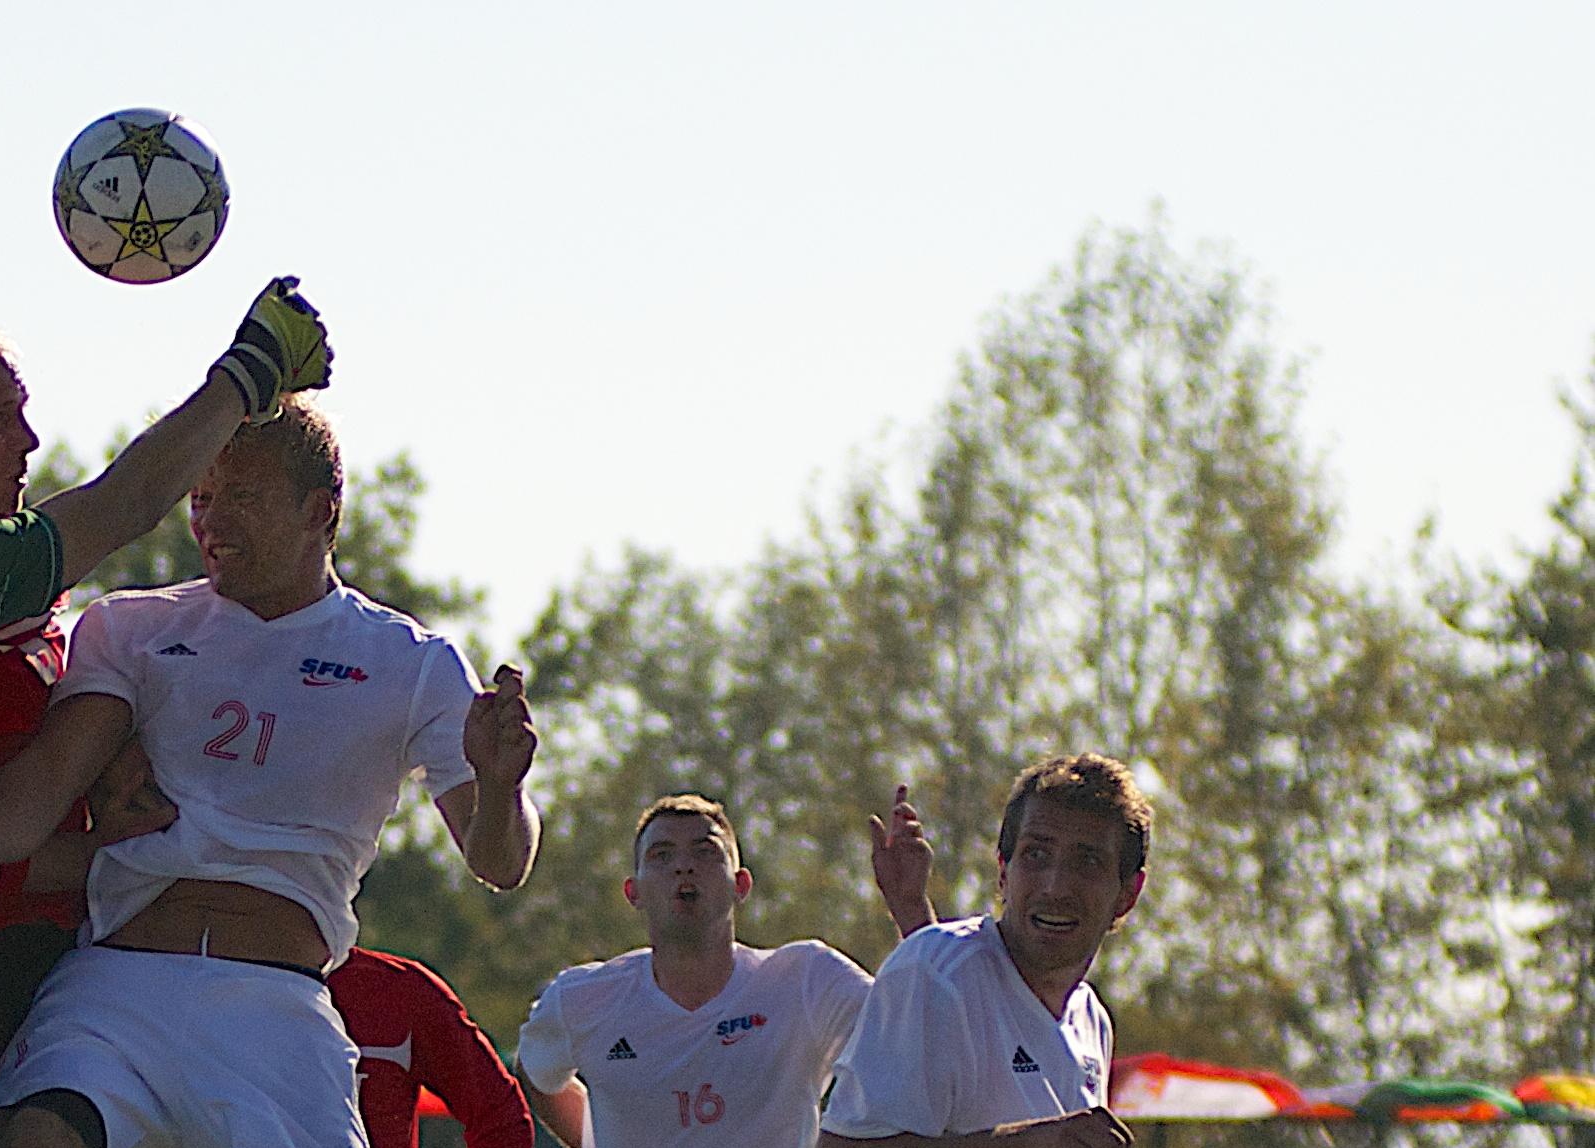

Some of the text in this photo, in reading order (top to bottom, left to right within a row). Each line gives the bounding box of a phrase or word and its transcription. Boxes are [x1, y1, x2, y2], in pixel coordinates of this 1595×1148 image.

[299, 658, 353, 680] SFU
[203, 700, 277, 766] 21
[716, 1015, 752, 1036] SFU
[671, 1082, 725, 1128] 16
